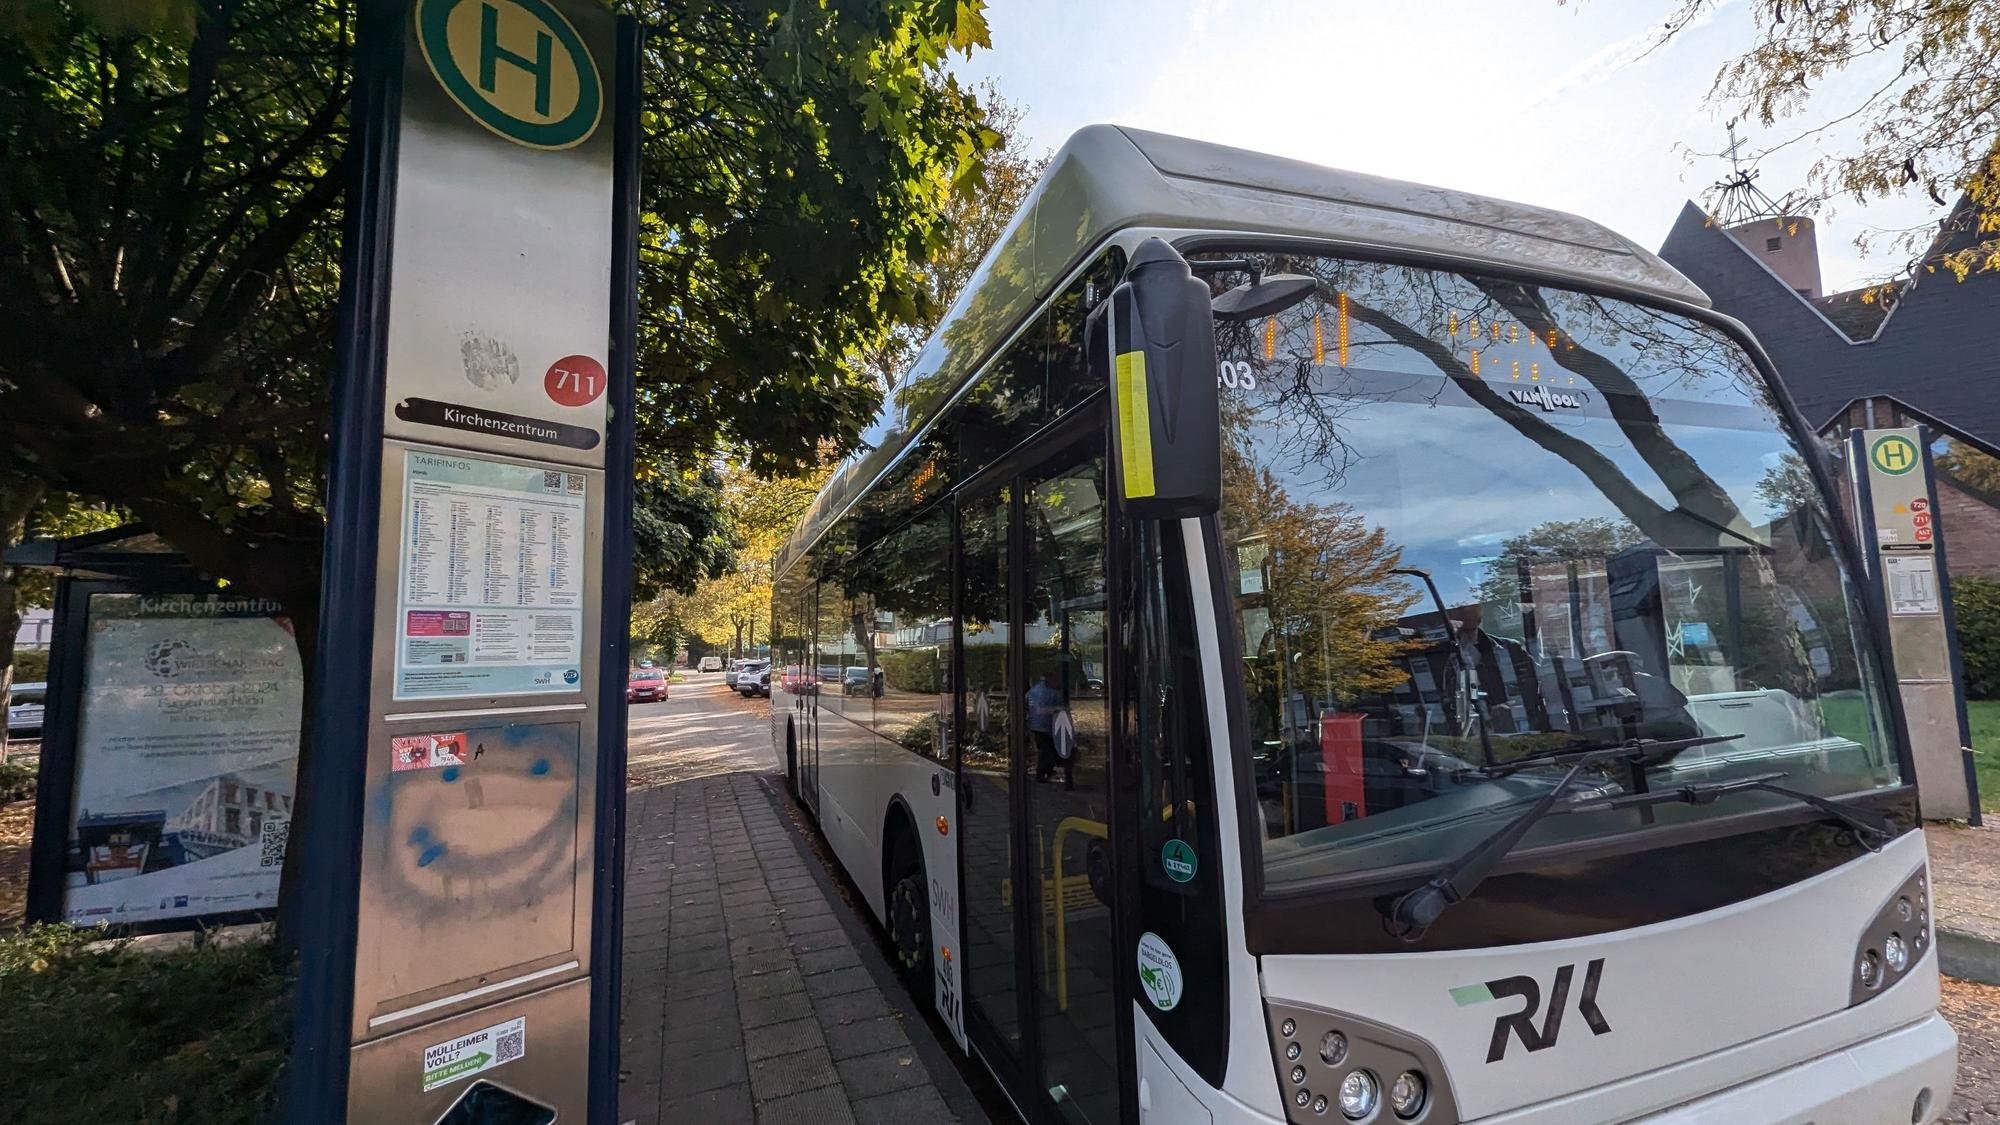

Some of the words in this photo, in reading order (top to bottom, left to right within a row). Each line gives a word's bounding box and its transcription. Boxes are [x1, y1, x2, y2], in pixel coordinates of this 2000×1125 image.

[479, 2, 552, 117] H
[555, 369, 594, 396] 711
[1217, 361, 1256, 390] 03
[444, 408, 558, 440] Kirchenzentrum
[415, 456, 471, 471] TARIFINFOS
[1884, 443, 1906, 467] H
[535, 677, 551, 685] SWH
[1174, 843, 1184, 862] 4
[932, 878, 954, 926] SWH
[426, 1032, 489, 1060] MÜLLEIMER
[425, 1070, 449, 1082] BITTE
[449, 1057, 483, 1072] MELDEN!
[426, 1051, 461, 1069] VOLL?
